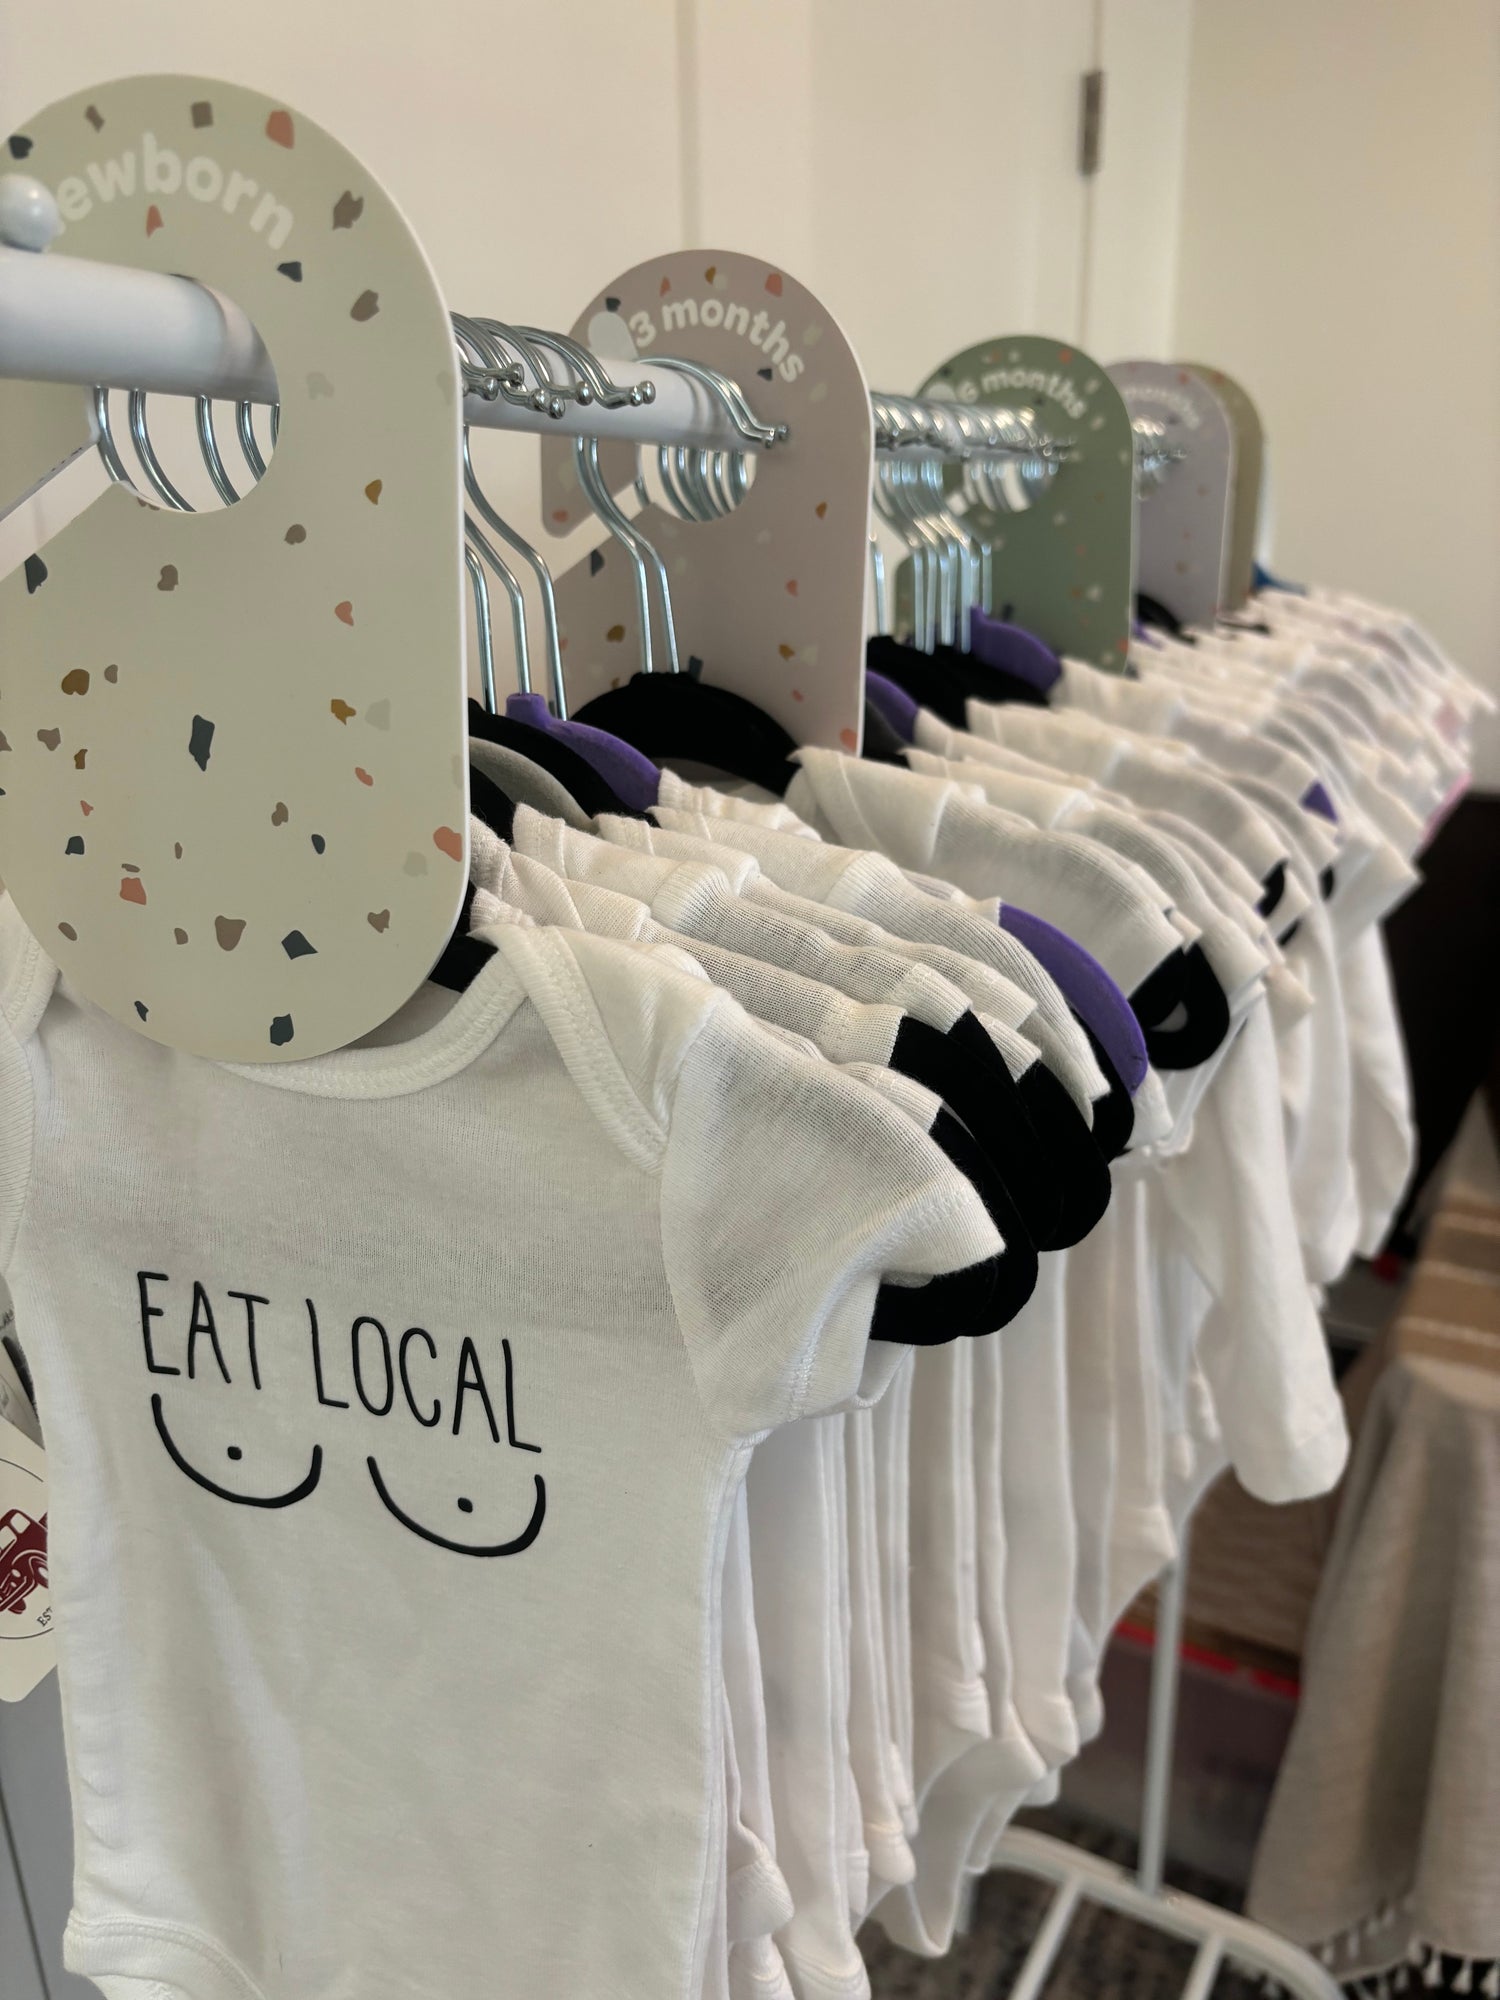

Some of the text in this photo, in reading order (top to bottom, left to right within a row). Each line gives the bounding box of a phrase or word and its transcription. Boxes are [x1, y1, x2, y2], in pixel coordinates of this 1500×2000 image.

[57, 132, 293, 250] ewborn
[661, 298, 804, 383] months
[981, 369, 1087, 420] months
[138, 1271, 541, 1453] EAT LOCAL
